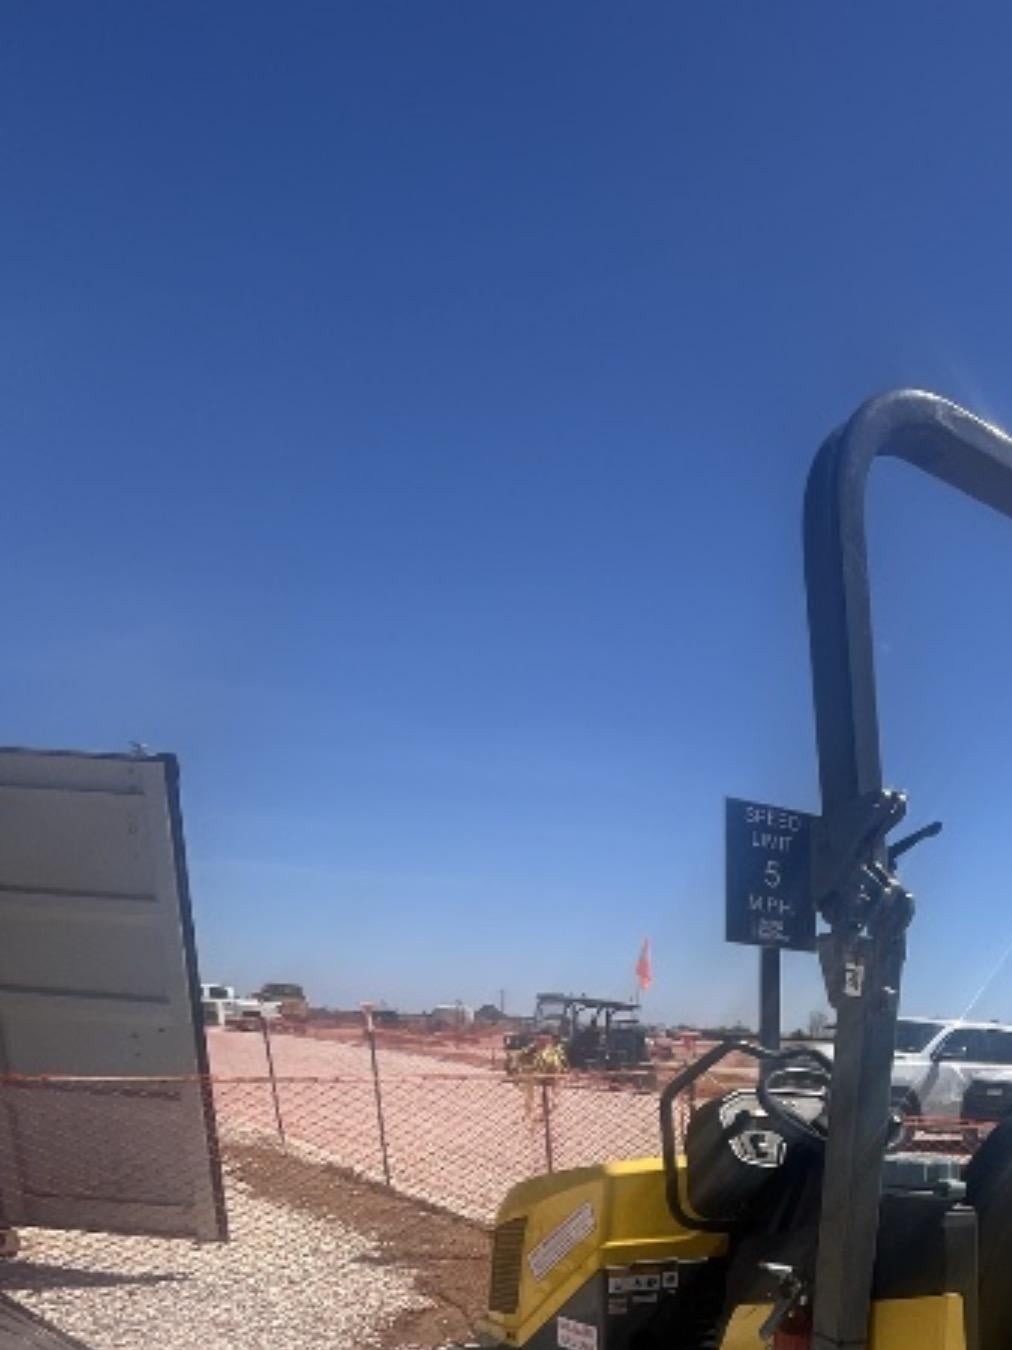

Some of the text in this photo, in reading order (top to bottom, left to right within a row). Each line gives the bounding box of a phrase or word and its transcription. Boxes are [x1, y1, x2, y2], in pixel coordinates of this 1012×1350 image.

[745, 806, 801, 832] SPEED
[751, 830, 793, 851] LIMIT
[764, 860, 781, 888] 5
